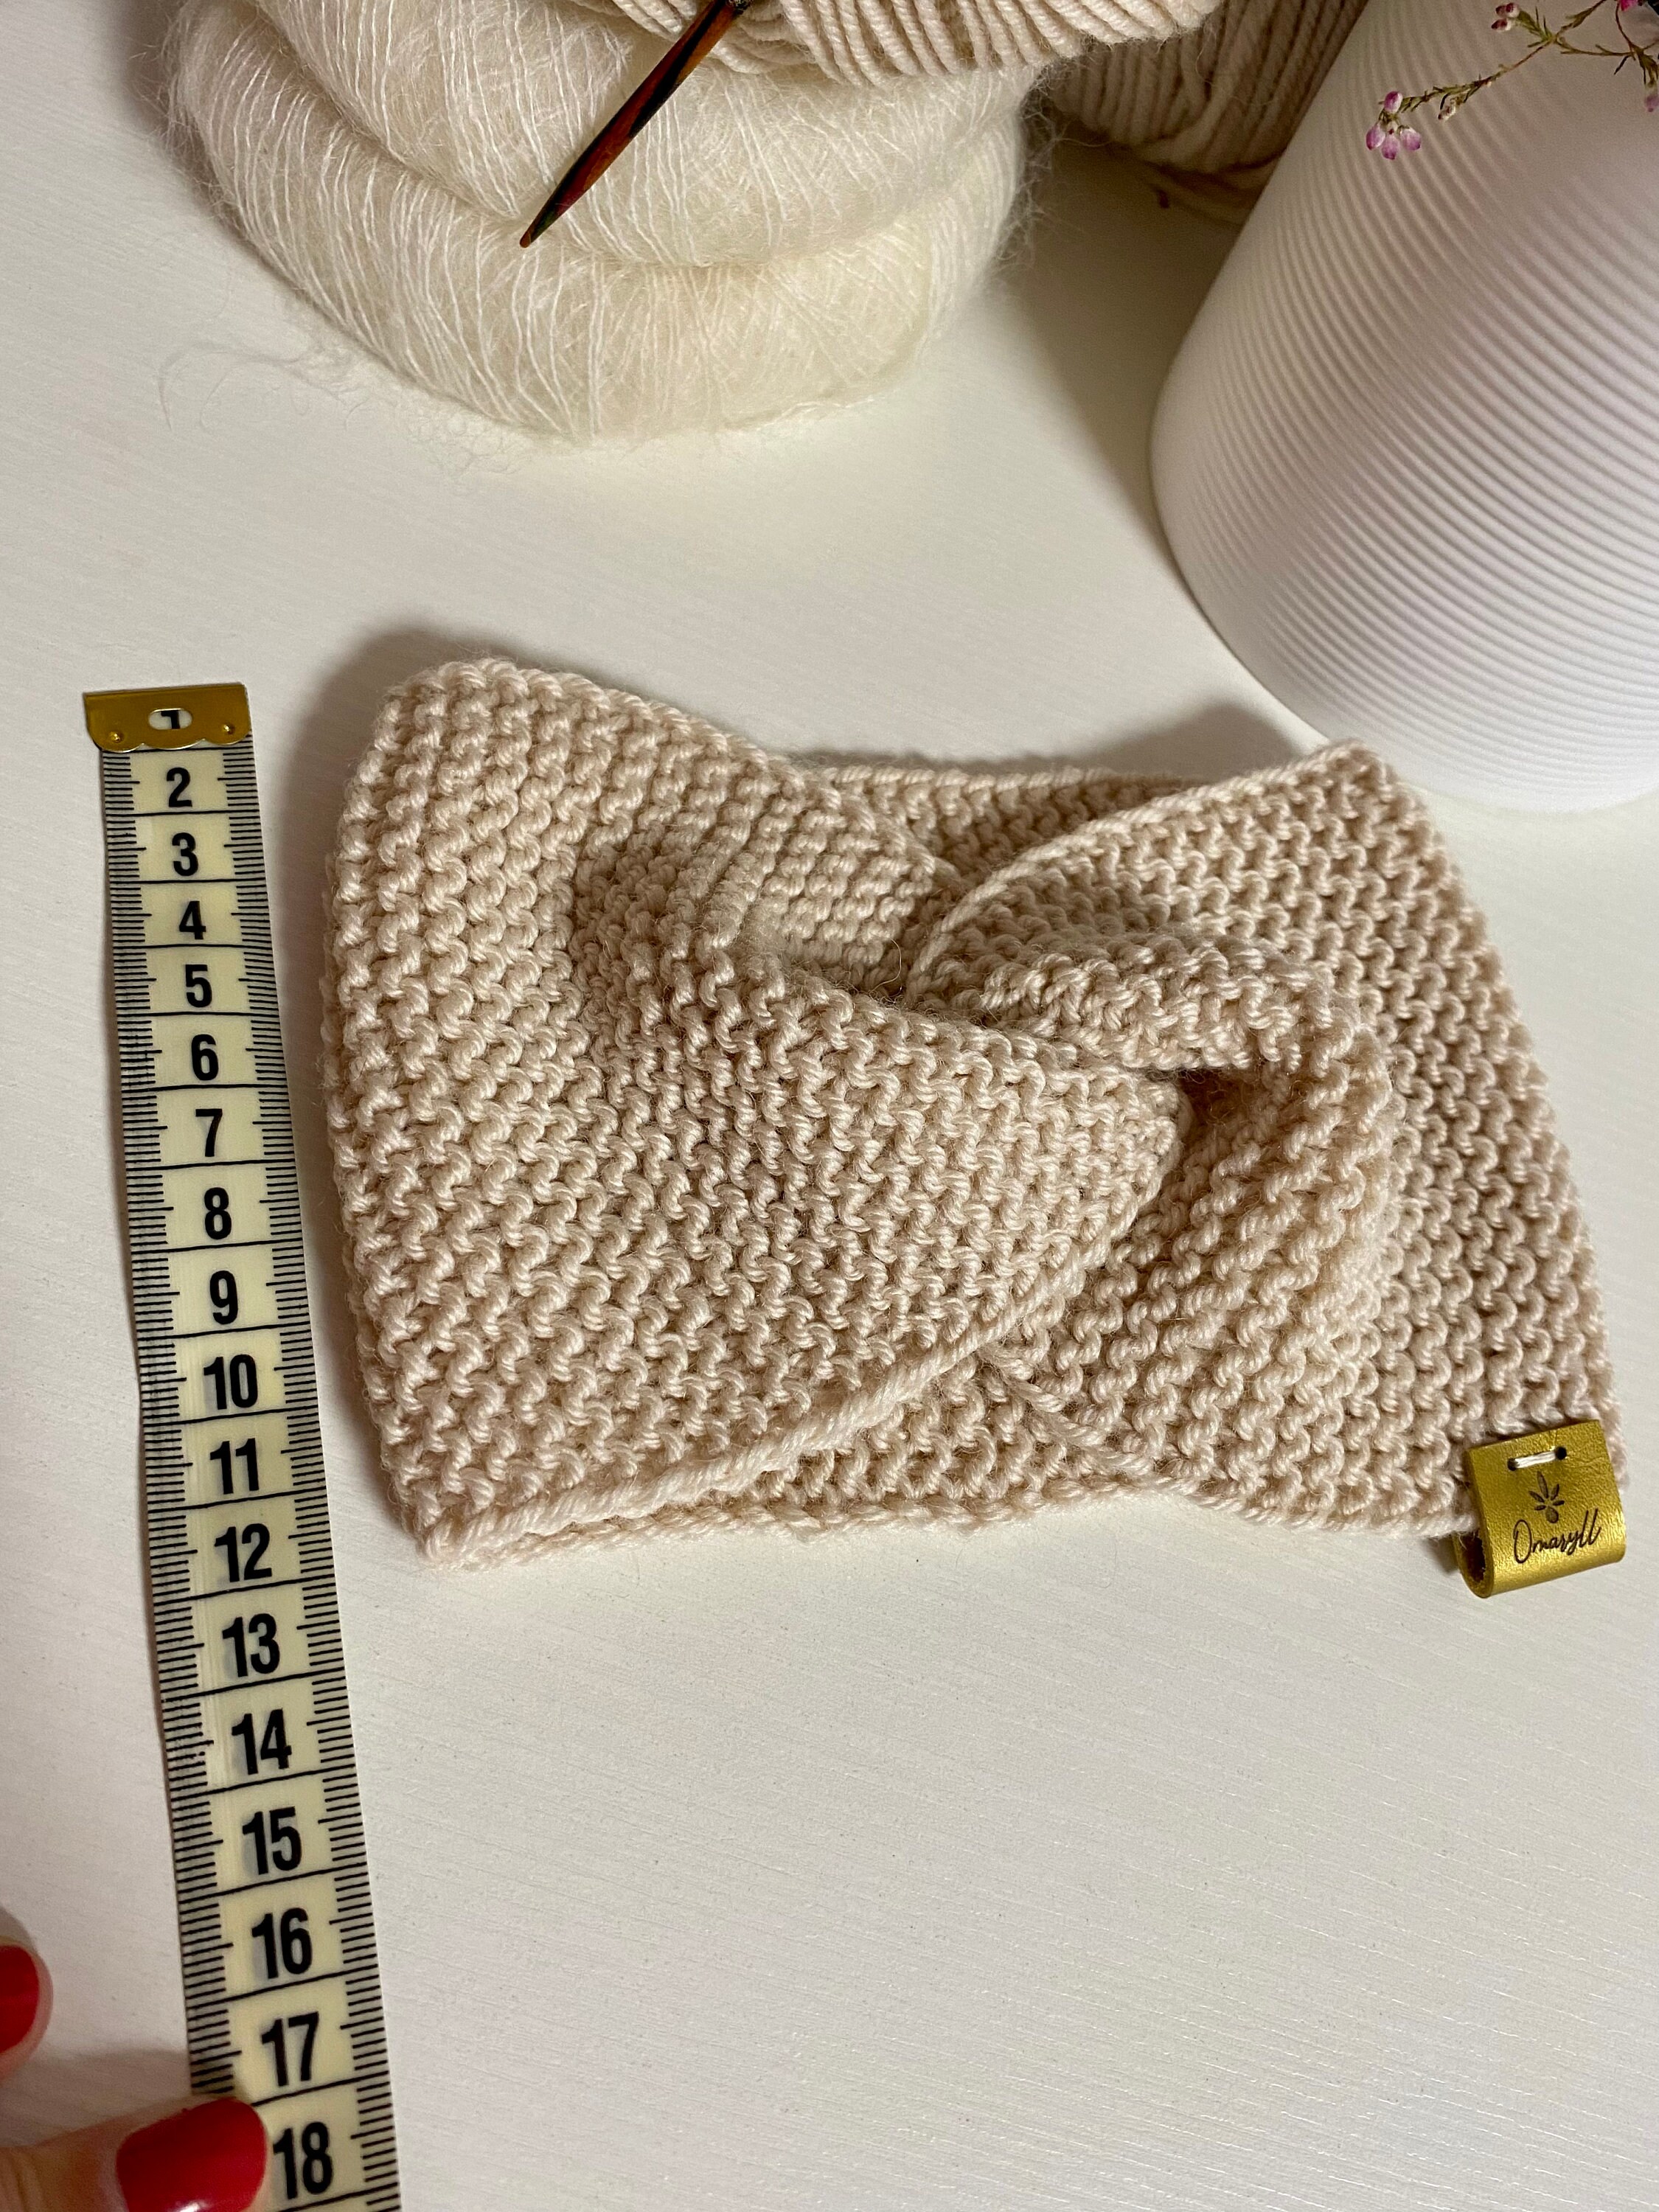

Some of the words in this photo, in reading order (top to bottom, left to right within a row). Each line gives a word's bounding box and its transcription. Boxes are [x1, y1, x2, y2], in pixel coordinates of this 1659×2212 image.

[166, 768, 192, 807] 2
[172, 832, 198, 877] 3
[178, 901, 206, 940] 4
[185, 964, 212, 1008] 5
[191, 1034, 219, 1081] 6
[195, 1108, 223, 1157] 7
[204, 1187, 232, 1240] 8
[210, 1270, 239, 1325] 9
[204, 1354, 259, 1410] 10
[210, 1438, 260, 1495] 11
[214, 1523, 273, 1582] 12
[222, 1613, 281, 1677] 13
[232, 1708, 293, 1775] 14
[243, 1806, 302, 1875] 15
[251, 1907, 313, 1980] 16
[260, 2011, 320, 2087] 17
[272, 2121, 335, 2201] 18
